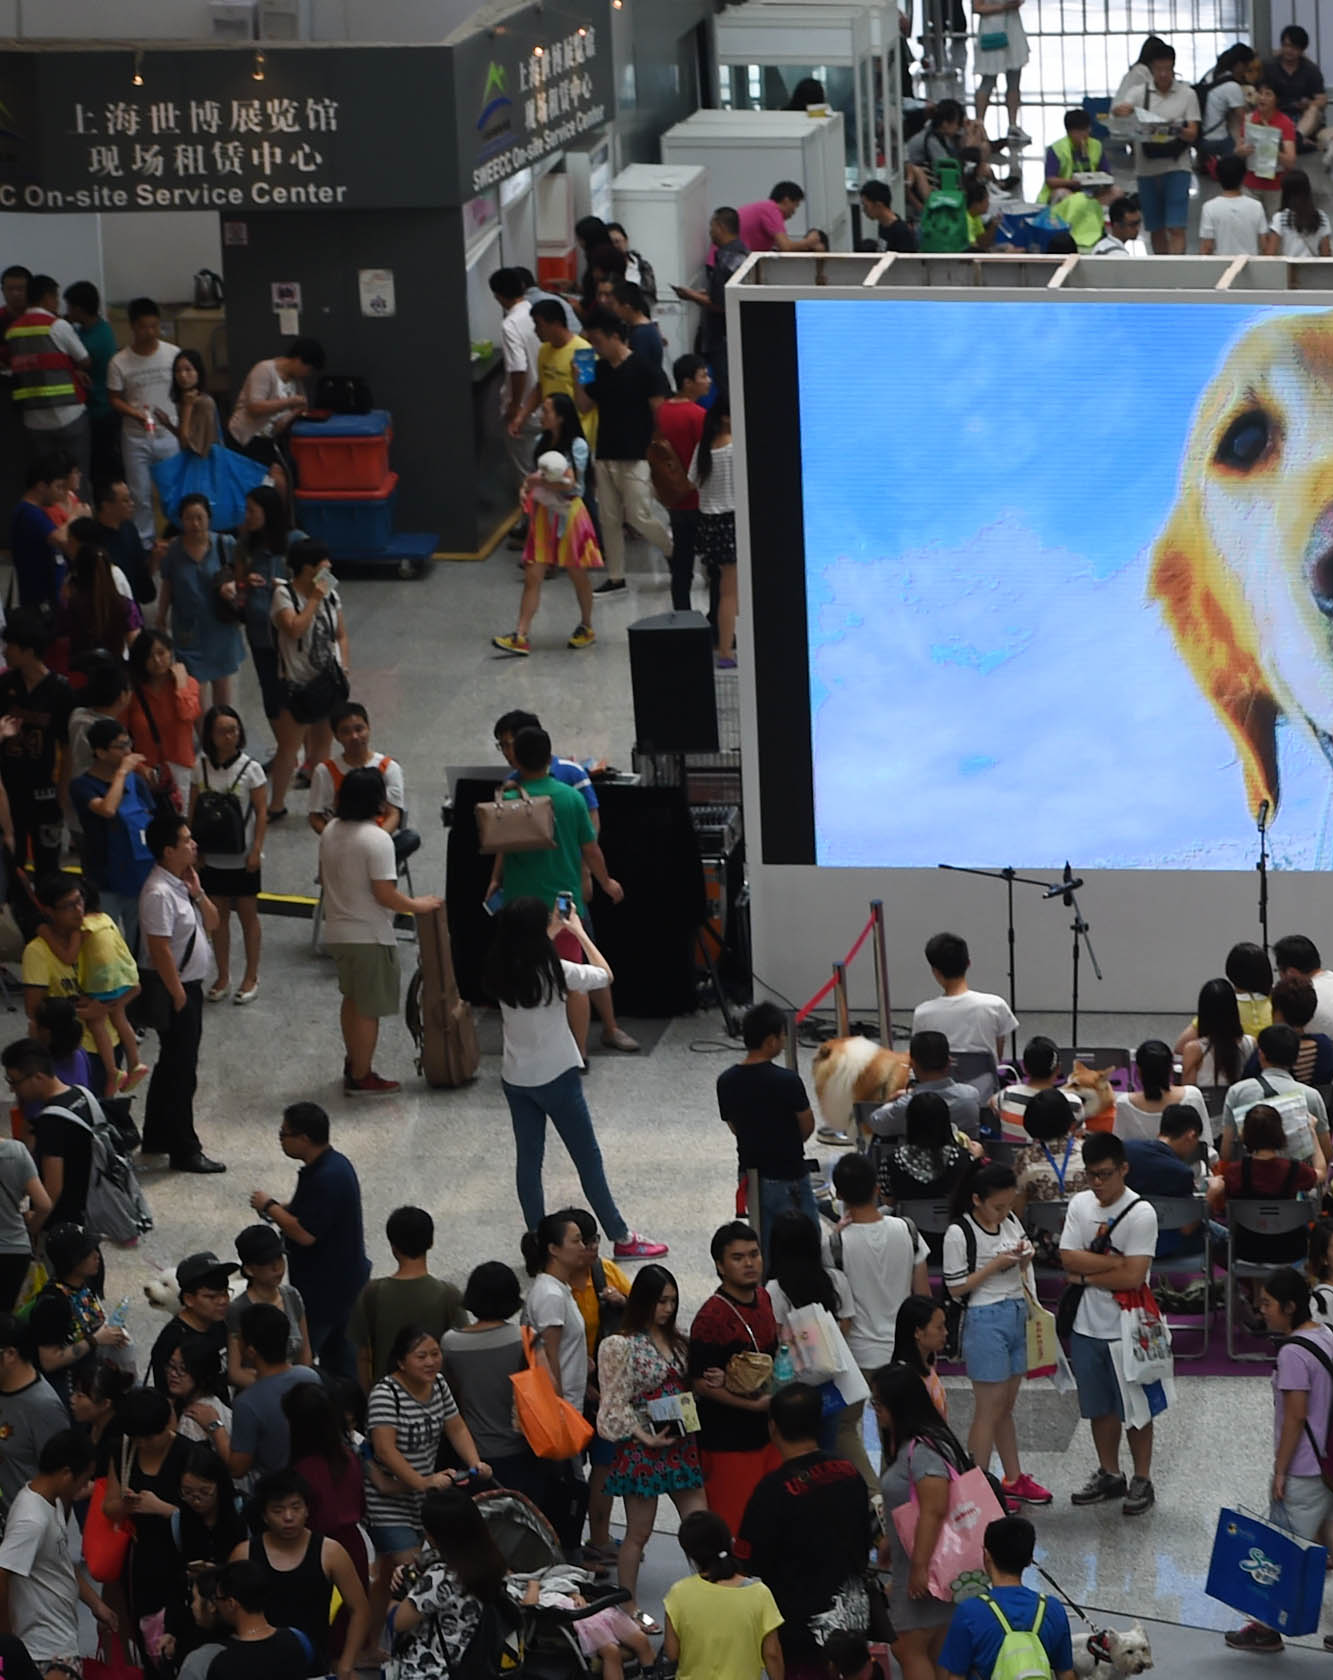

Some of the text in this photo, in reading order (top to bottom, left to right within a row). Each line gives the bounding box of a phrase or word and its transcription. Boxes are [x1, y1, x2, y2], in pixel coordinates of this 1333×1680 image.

[66, 98, 340, 136] 上海世博展览馆
[543, 120, 577, 151] Service
[88, 140, 323, 177] 现场租赁中心
[24, 184, 128, 207] On-site
[136, 183, 243, 206] Service
[251, 182, 347, 204] Center
